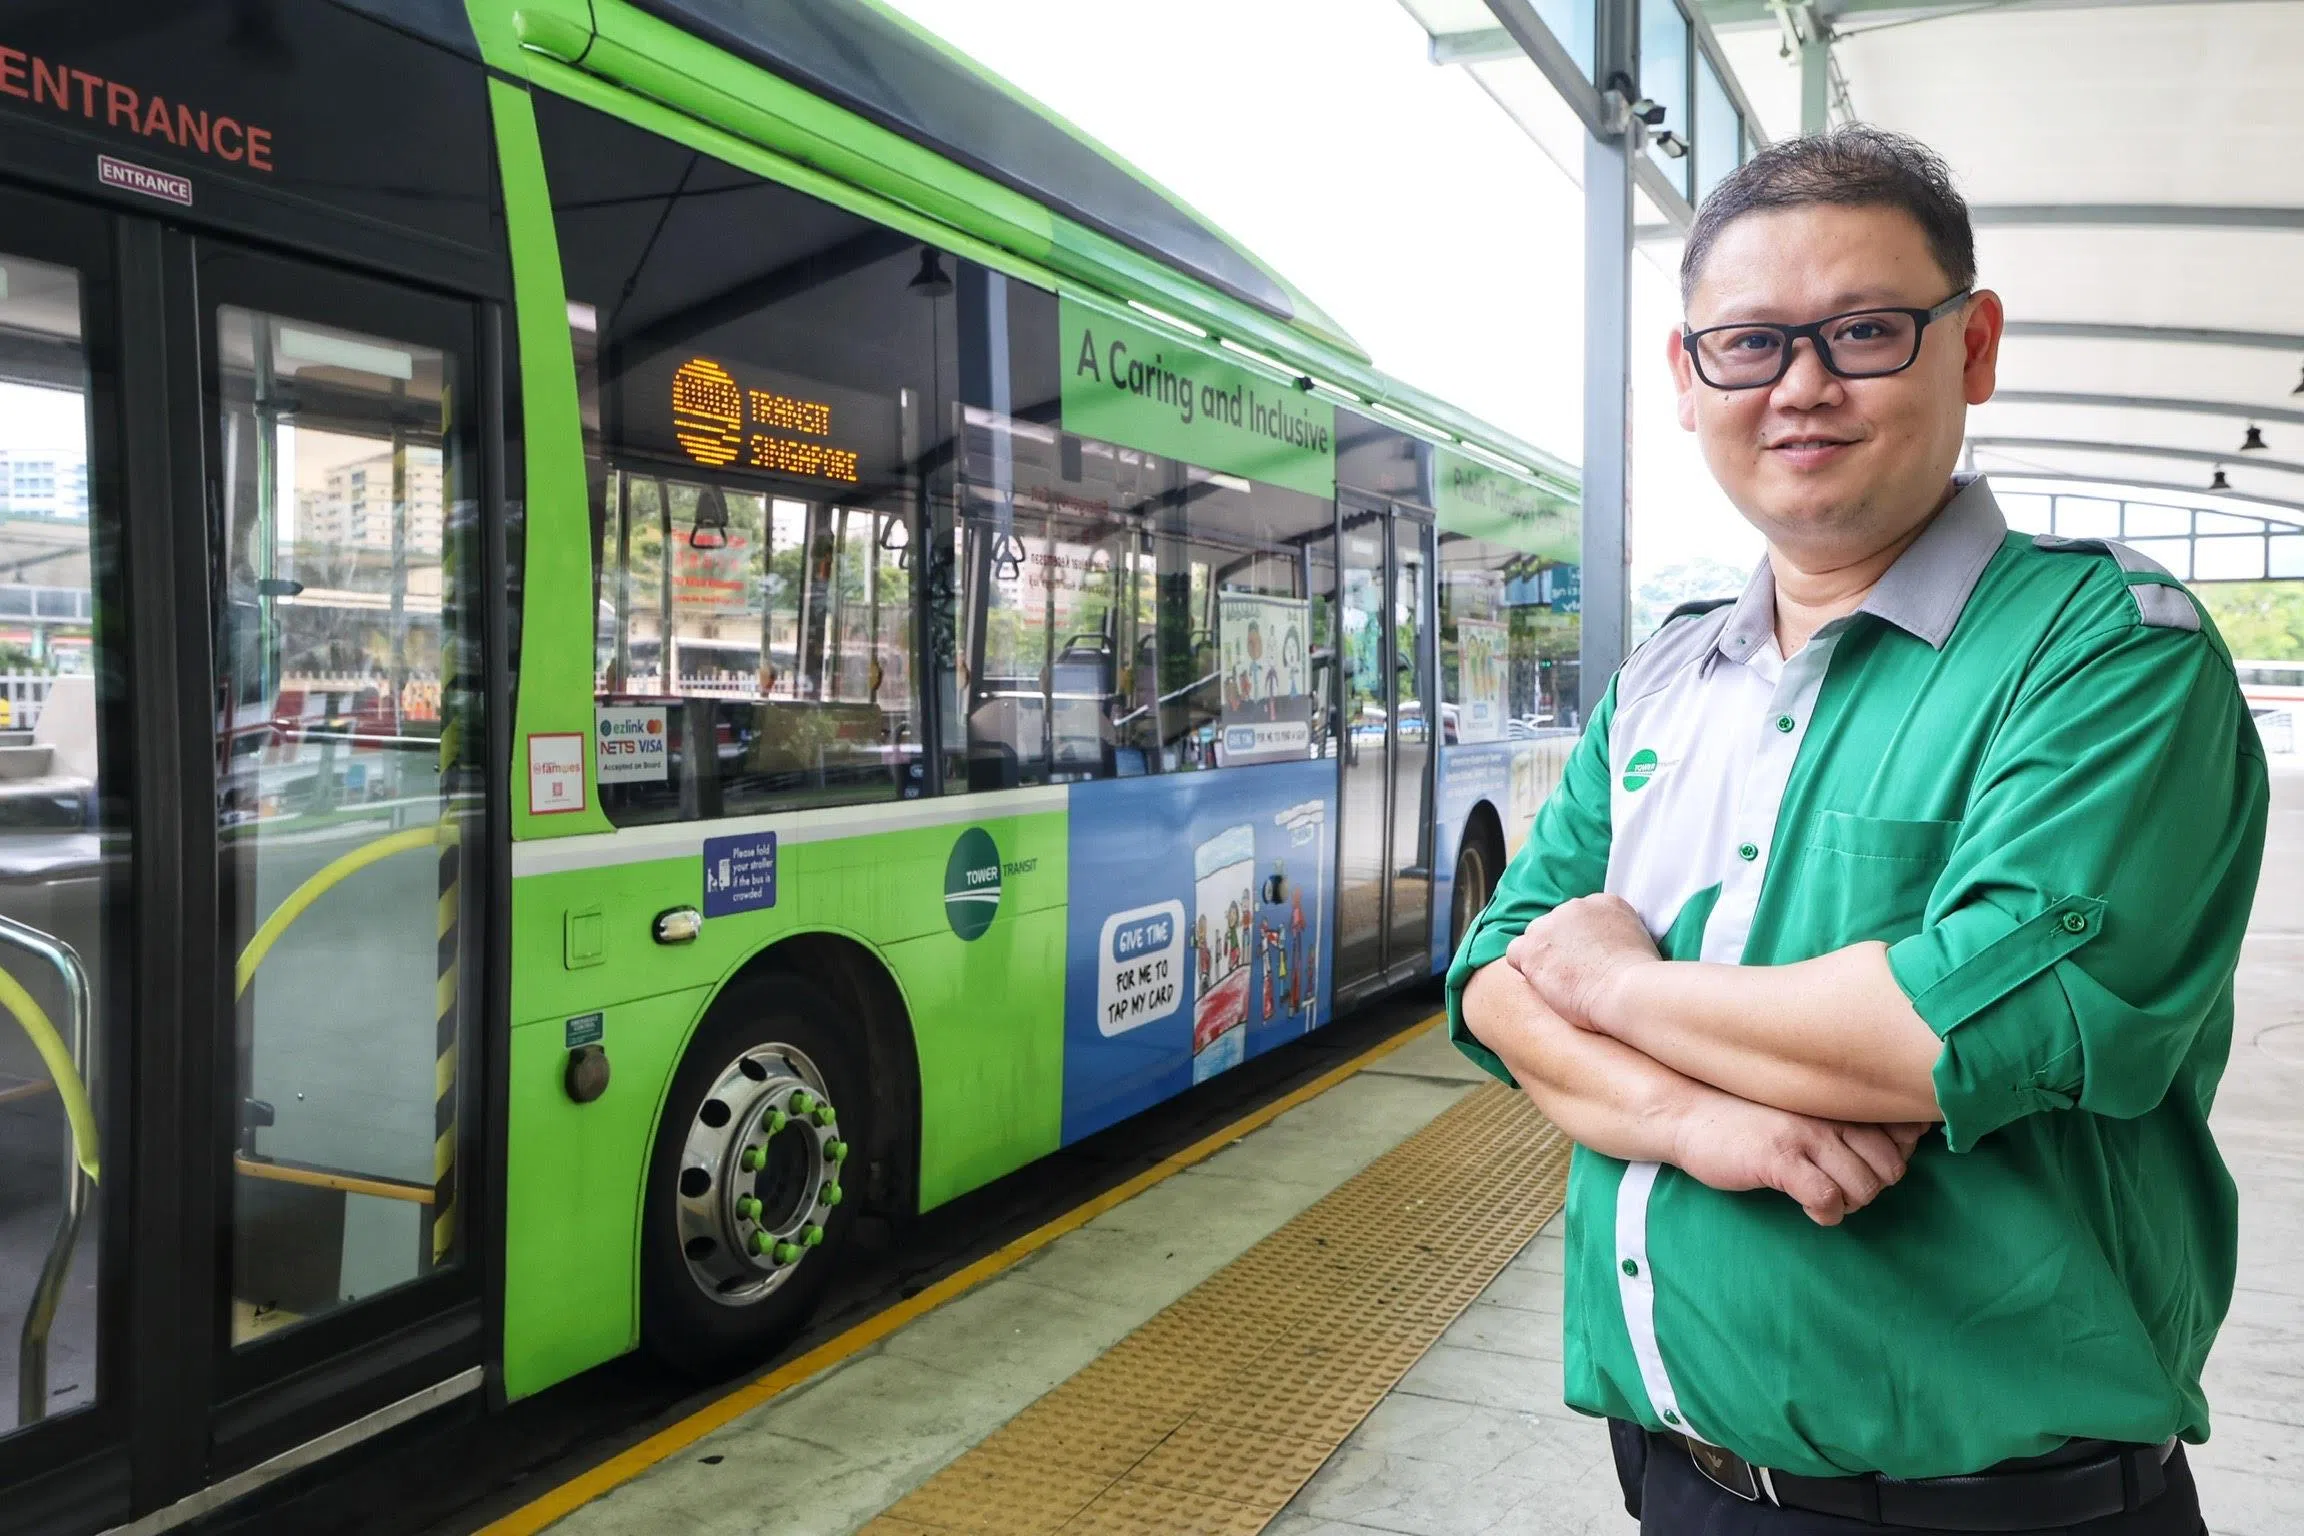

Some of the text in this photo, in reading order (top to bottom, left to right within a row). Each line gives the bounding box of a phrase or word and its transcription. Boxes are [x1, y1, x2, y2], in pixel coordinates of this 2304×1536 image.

[0, 44, 273, 172] ENTRANCE
[102, 163, 189, 199] ENTRANCE
[1077, 329, 1328, 454] A Caring and Inclusive
[749, 390, 830, 436] TRANSIT
[750, 434, 857, 482] SINGAPORE
[613, 719, 644, 734] ezlink
[600, 740, 663, 755] NETS VISA
[603, 762, 632, 771] Accepted
[644, 761, 661, 769] Board
[732, 843, 770, 859] Please fold
[732, 857, 774, 876] your stroller
[732, 873, 771, 888] if the bus is
[966, 857, 1038, 886] TOWER TRANSIT
[732, 886, 763, 902] crowded
[1119, 921, 1169, 953] GIVE TIME
[1116, 959, 1168, 993] FOR ME TO
[1108, 983, 1174, 1024] TAP MY CARD
